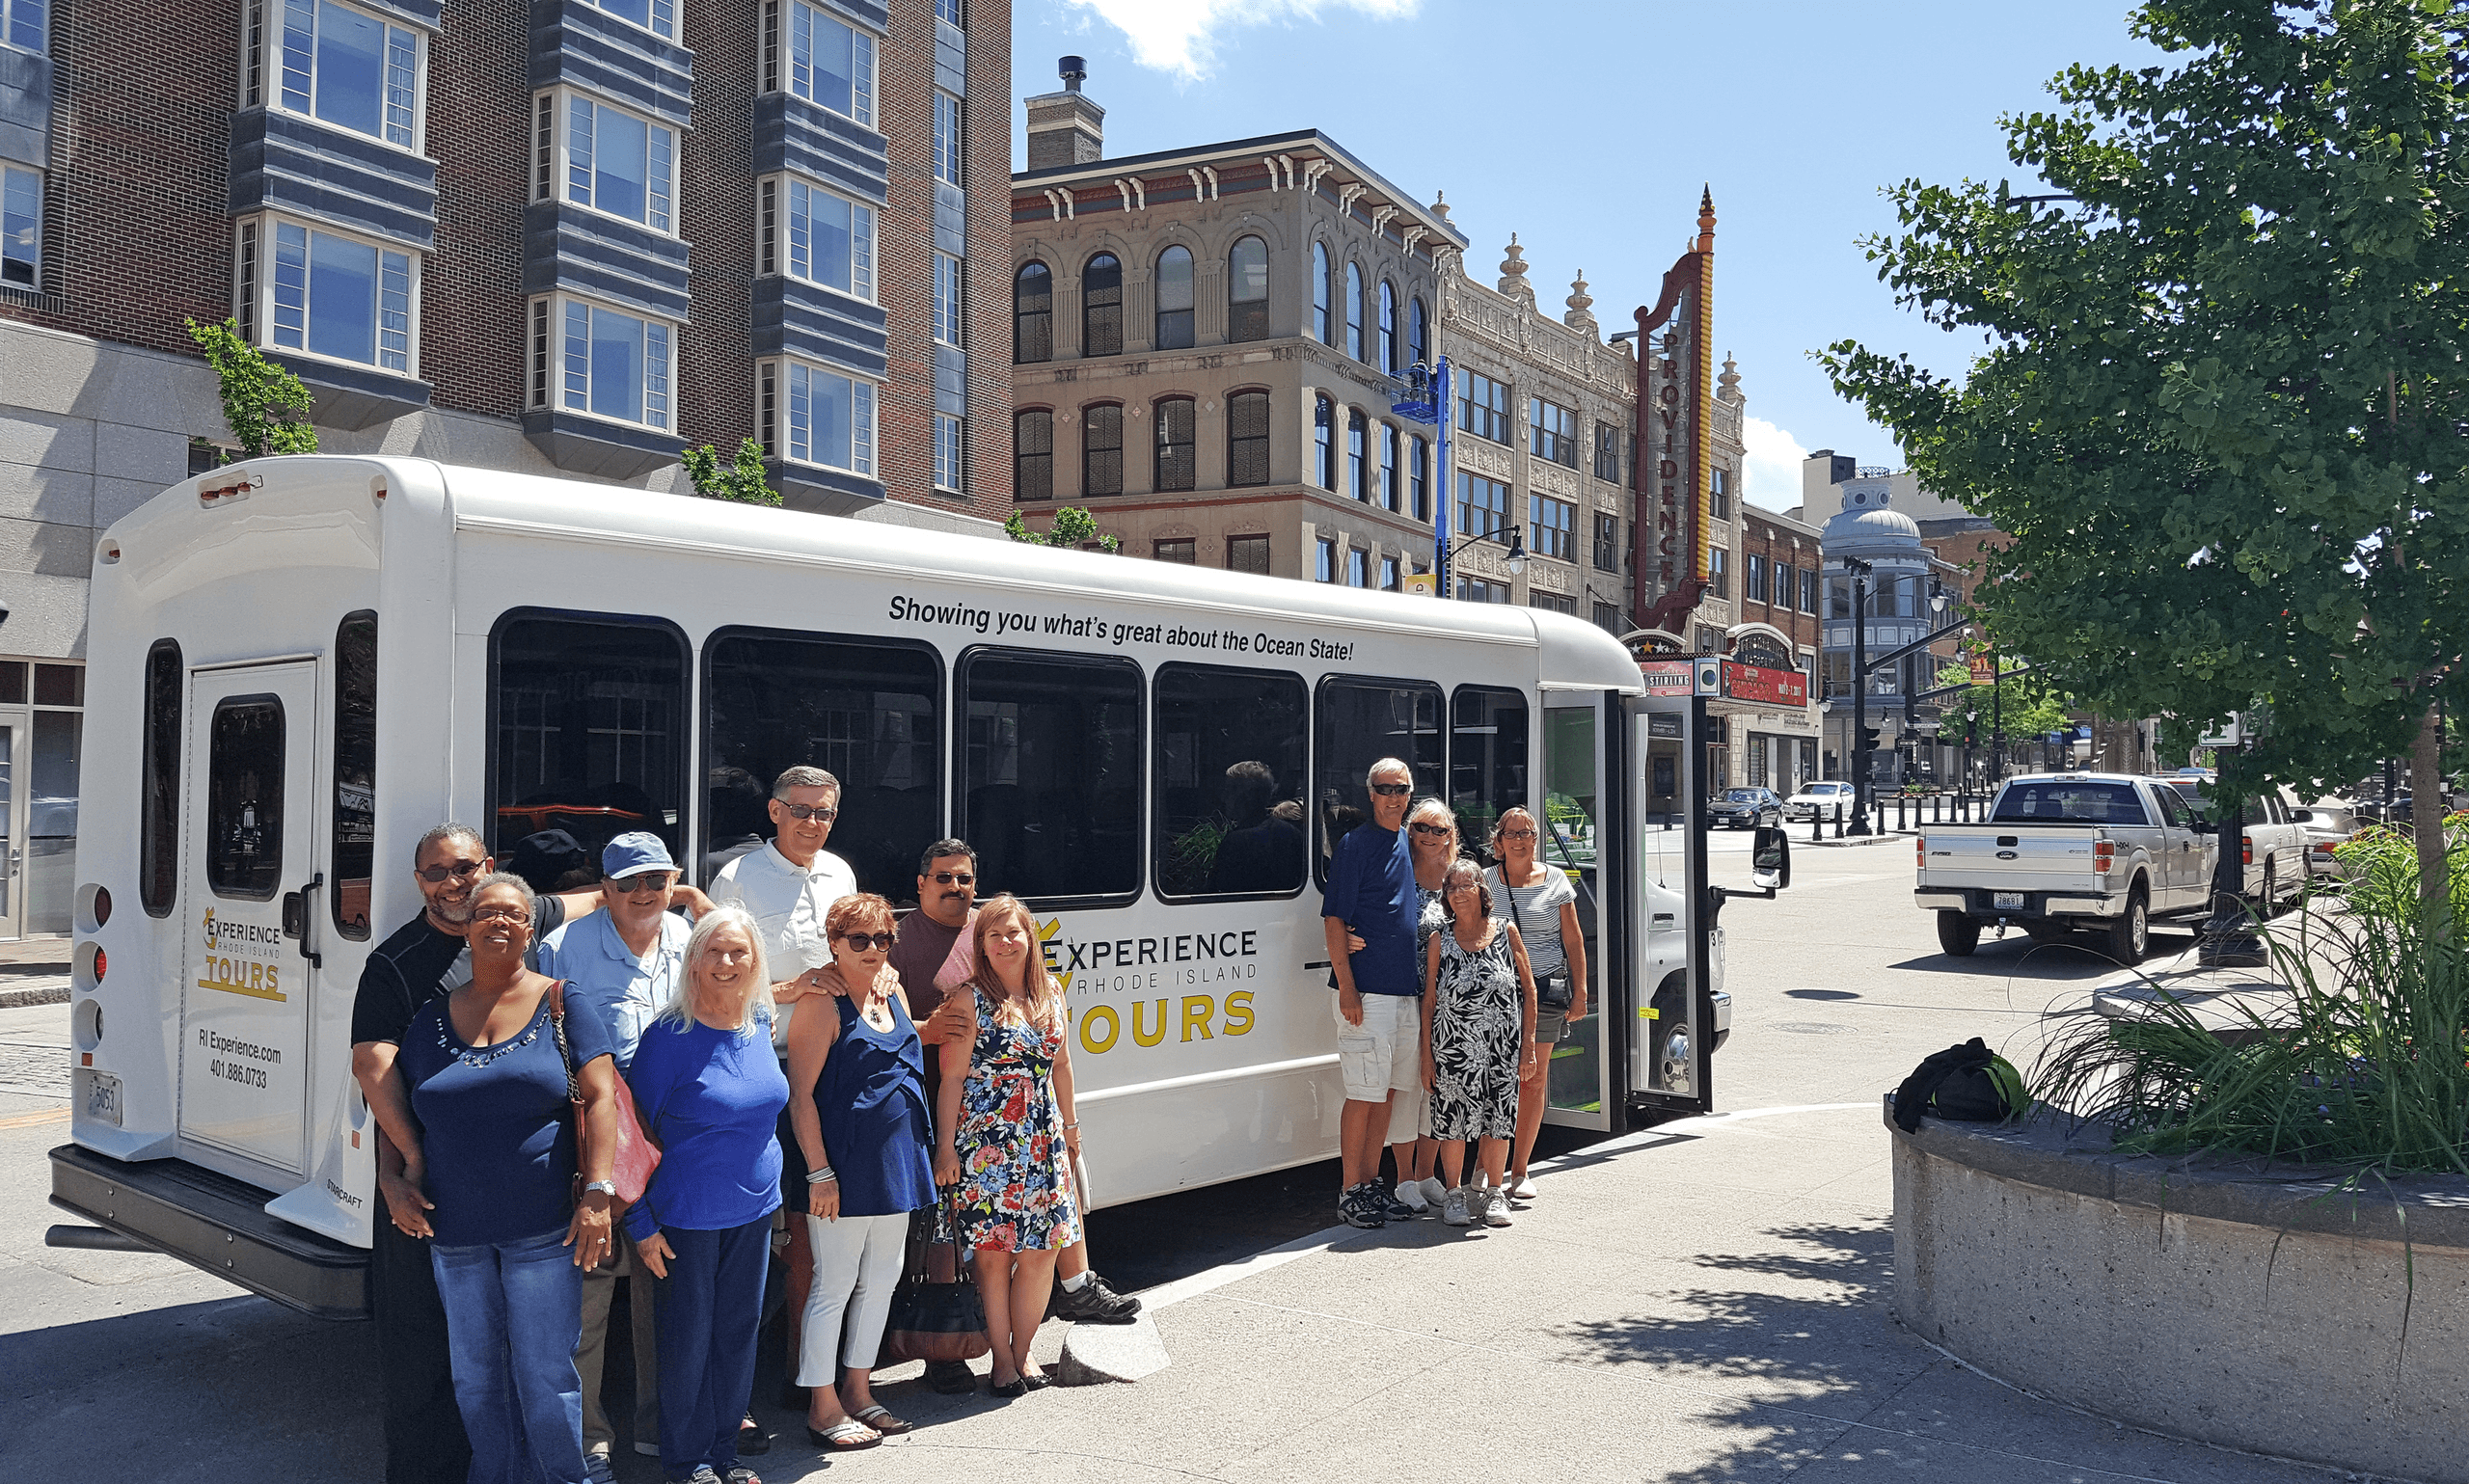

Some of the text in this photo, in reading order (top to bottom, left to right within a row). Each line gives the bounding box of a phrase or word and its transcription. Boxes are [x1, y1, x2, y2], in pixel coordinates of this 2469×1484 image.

[1659, 333, 1678, 582] PROVIDENCE
[888, 595, 991, 634] Showing
[996, 611, 1037, 635] you
[1112, 623, 1162, 646] great
[1166, 625, 1218, 650] about
[1222, 630, 1249, 652] the
[1254, 633, 1305, 657] Ocean
[1309, 638, 1355, 661] State!
[1649, 675, 1690, 687] STIRLING
[207, 917, 281, 945] EXPERIENCE
[1710, 932, 1717, 946] 3
[218, 941, 280, 959] RHODE ISLAND
[1041, 929, 1258, 973] EXPERIENCE
[205, 954, 279, 992] TOURS
[1077, 963, 1258, 995] RHODE ISLAND
[1067, 990, 1256, 1055] OURS
[199, 1028, 282, 1065] RI Experience.com
[209, 1058, 267, 1090] 401.886.0733
[327, 1178, 363, 1209] STARCRAFT
